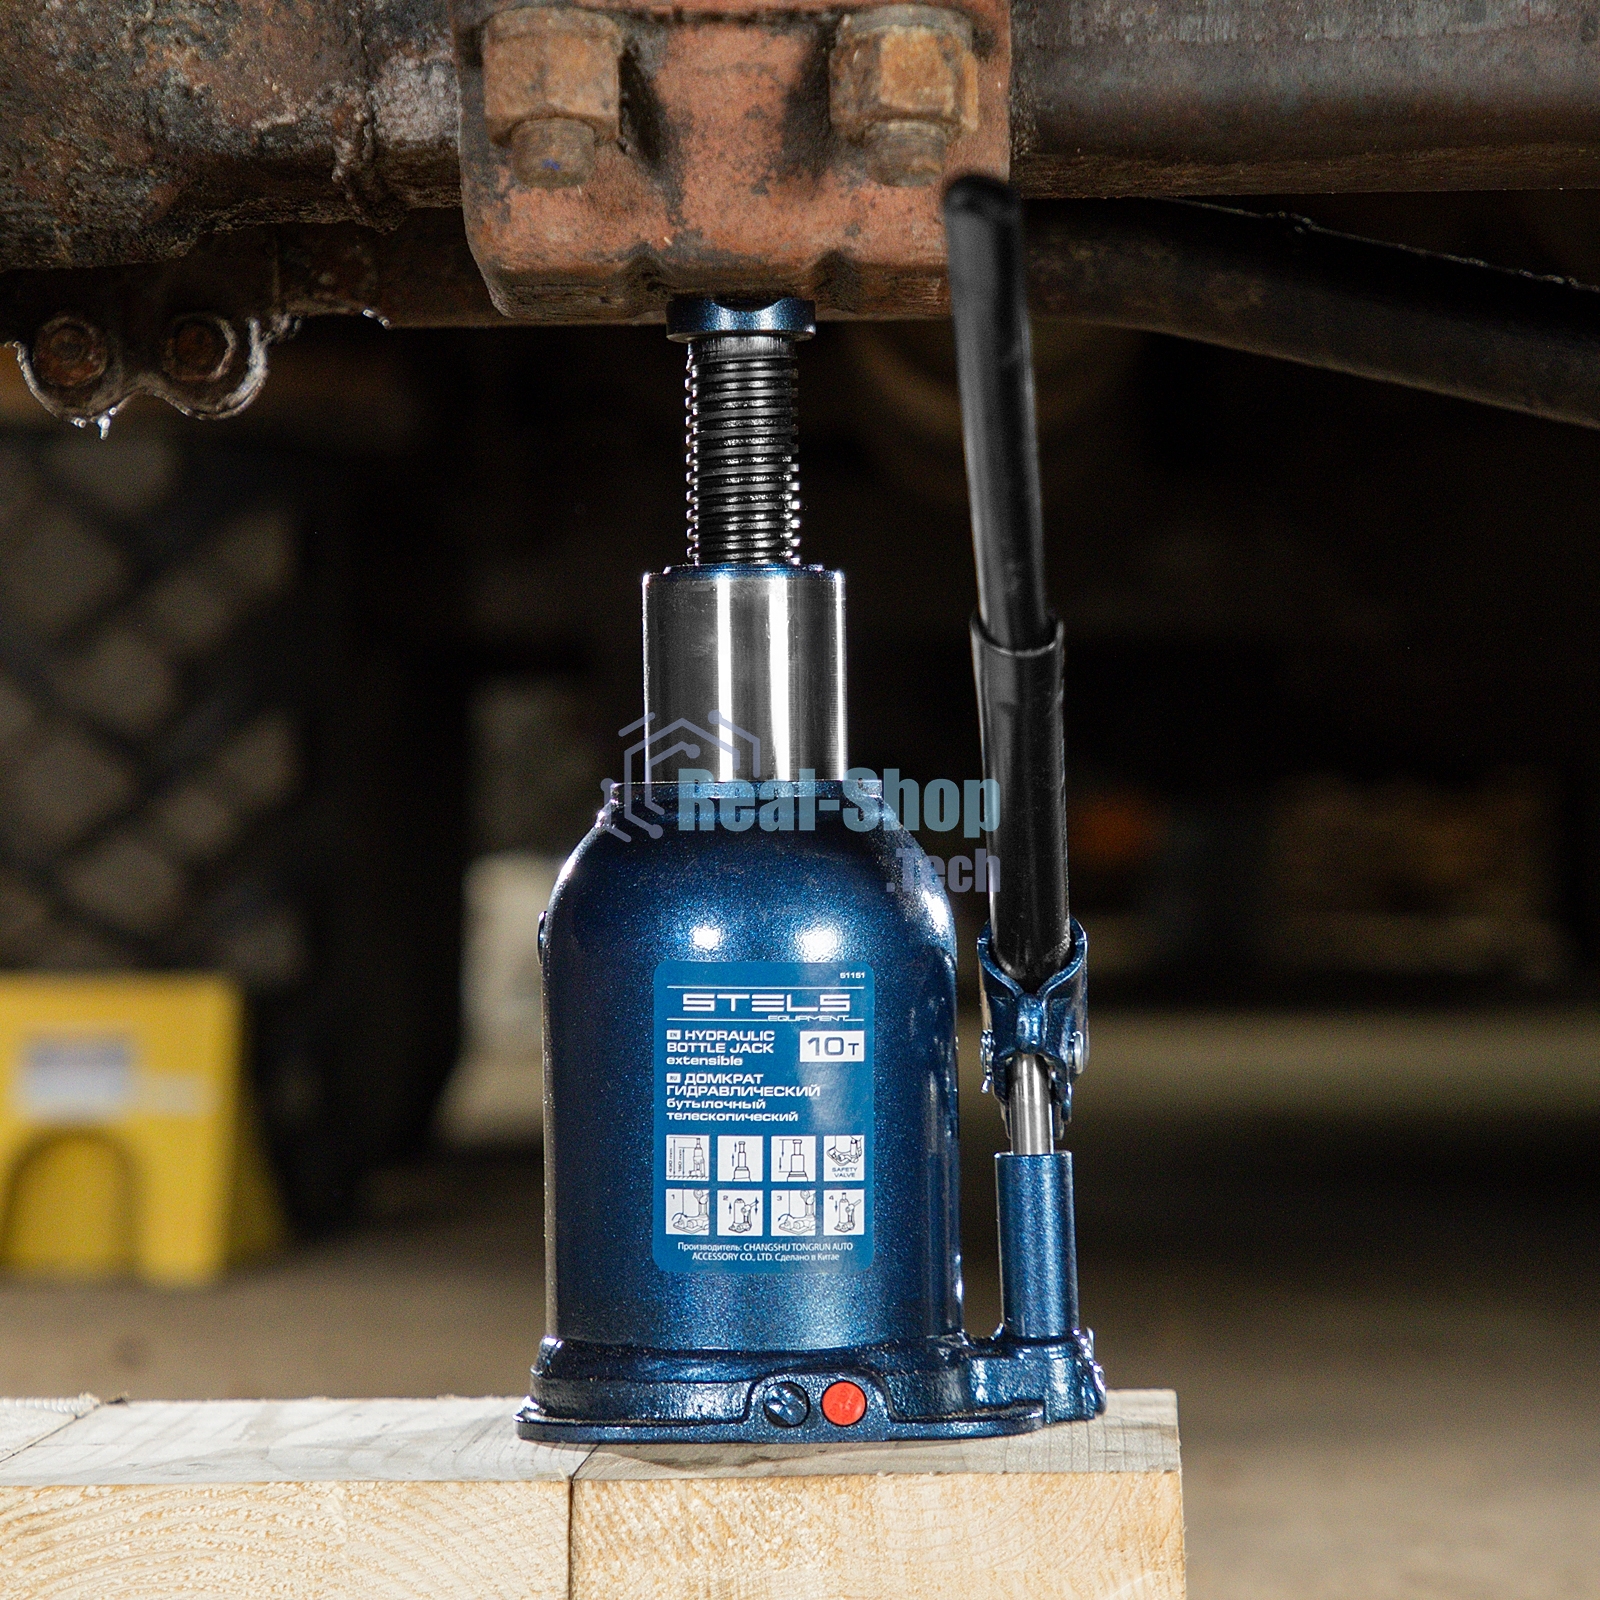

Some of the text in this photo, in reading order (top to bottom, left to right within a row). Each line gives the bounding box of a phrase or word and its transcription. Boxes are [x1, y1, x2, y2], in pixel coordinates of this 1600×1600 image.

[683, 994, 850, 1012] STELS
[685, 1030, 775, 1041] HYDRAULIC
[667, 1043, 774, 1054] BOTTLE JACK
[667, 1055, 743, 1066] extensible
[684, 1074, 764, 1085] ДОМКРАТ
[667, 1085, 821, 1098] ГИДРАВЛИЧЕСКИЙ
[666, 1098, 766, 1110] бутылочный
[667, 1112, 799, 1122] телескопический
[677, 1242, 854, 1252] Производитель: CHANGSHU TONGRUN AUTO
[692, 1252, 739, 1261] ACCESSORY
[774, 1253, 810, 1262] Сделано
[817, 1253, 840, 1261] Китае
